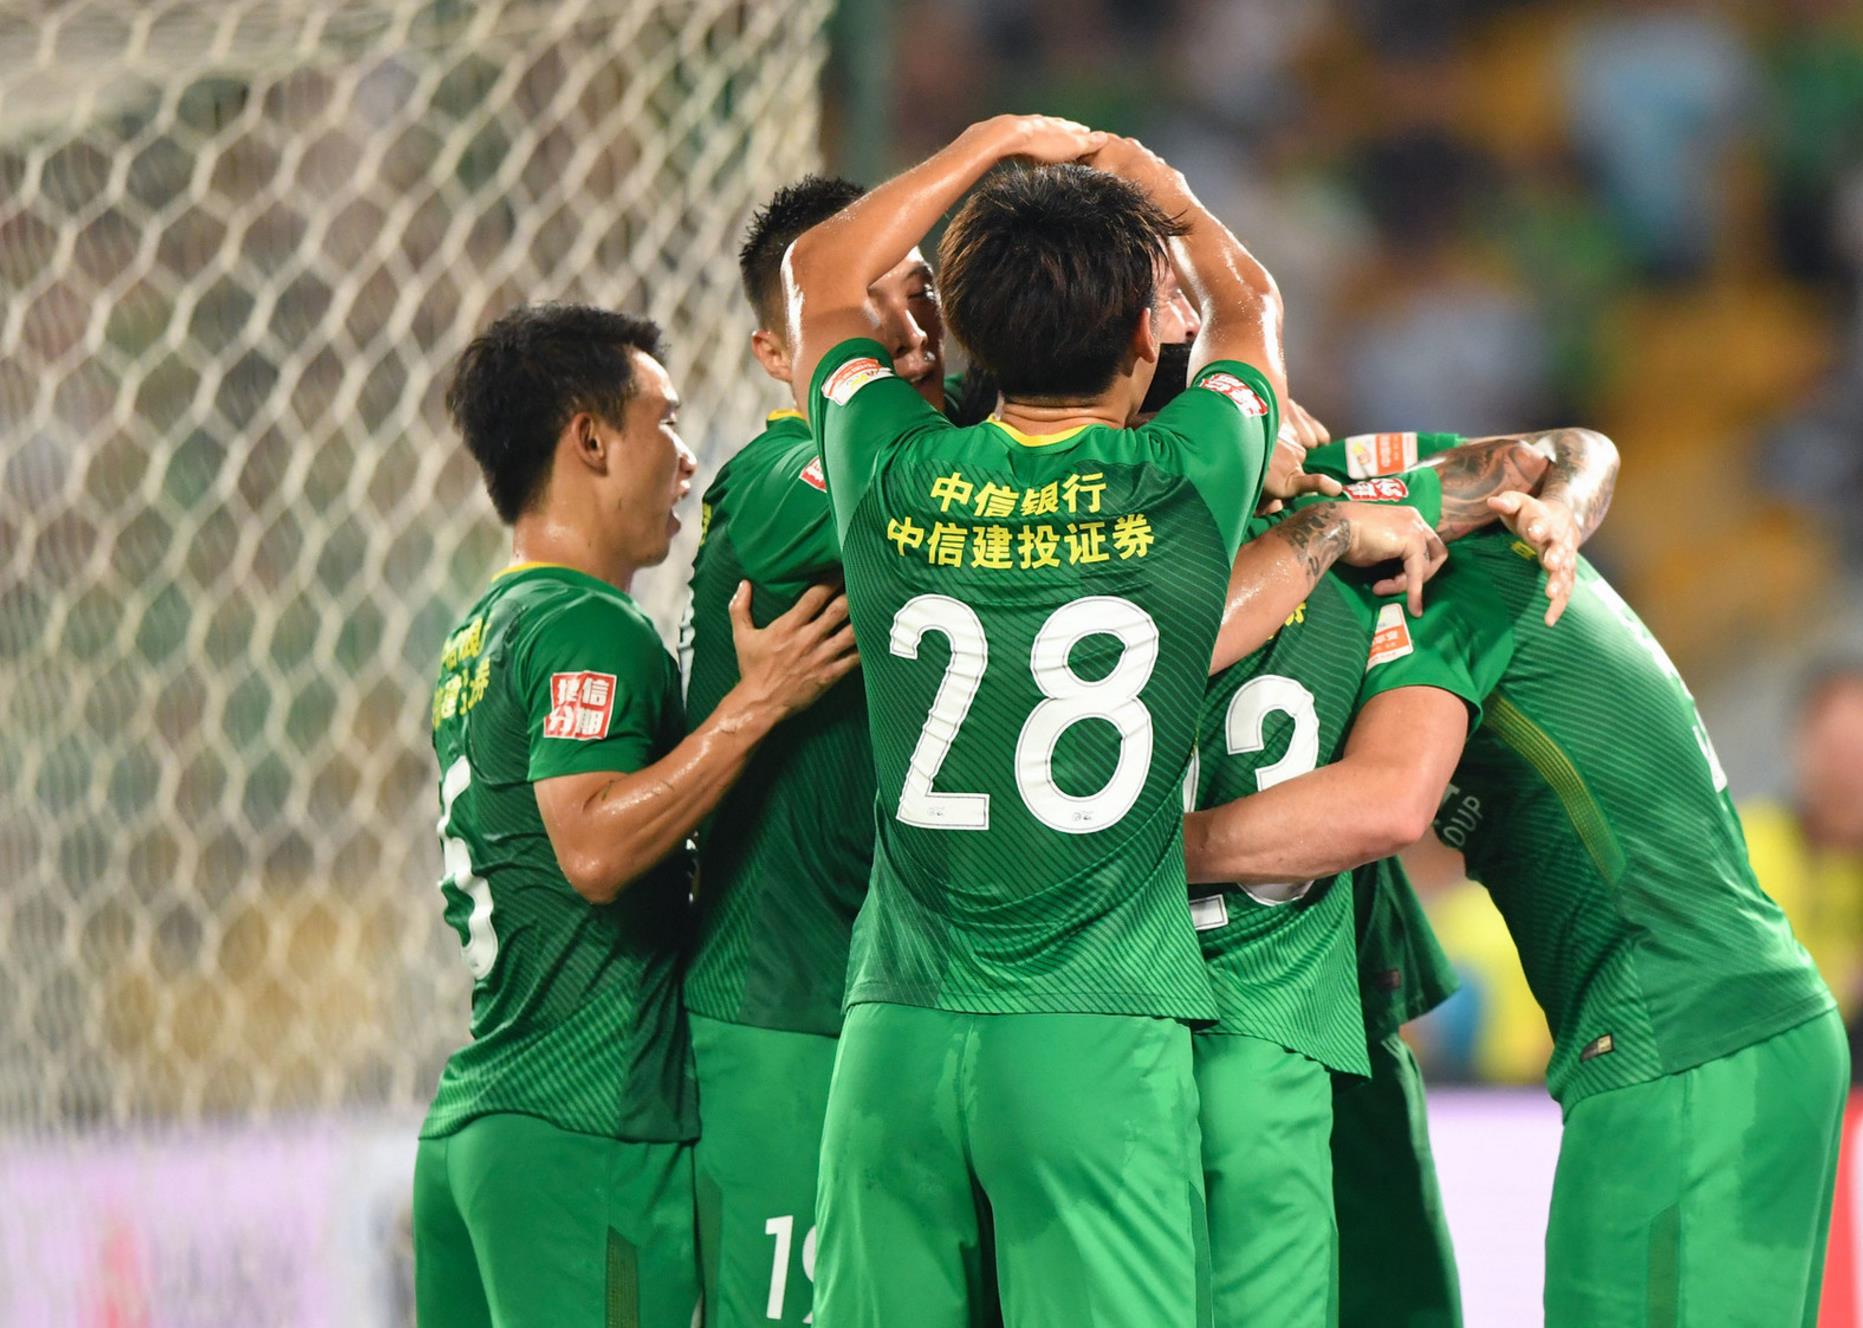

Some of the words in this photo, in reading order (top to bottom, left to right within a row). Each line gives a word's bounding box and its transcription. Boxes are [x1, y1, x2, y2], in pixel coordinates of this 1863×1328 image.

[930, 472, 1107, 517] 中信银行
[887, 514, 1155, 569] 中信建投证券
[889, 593, 1160, 834] 28
[1434, 796, 1483, 847] OUP
